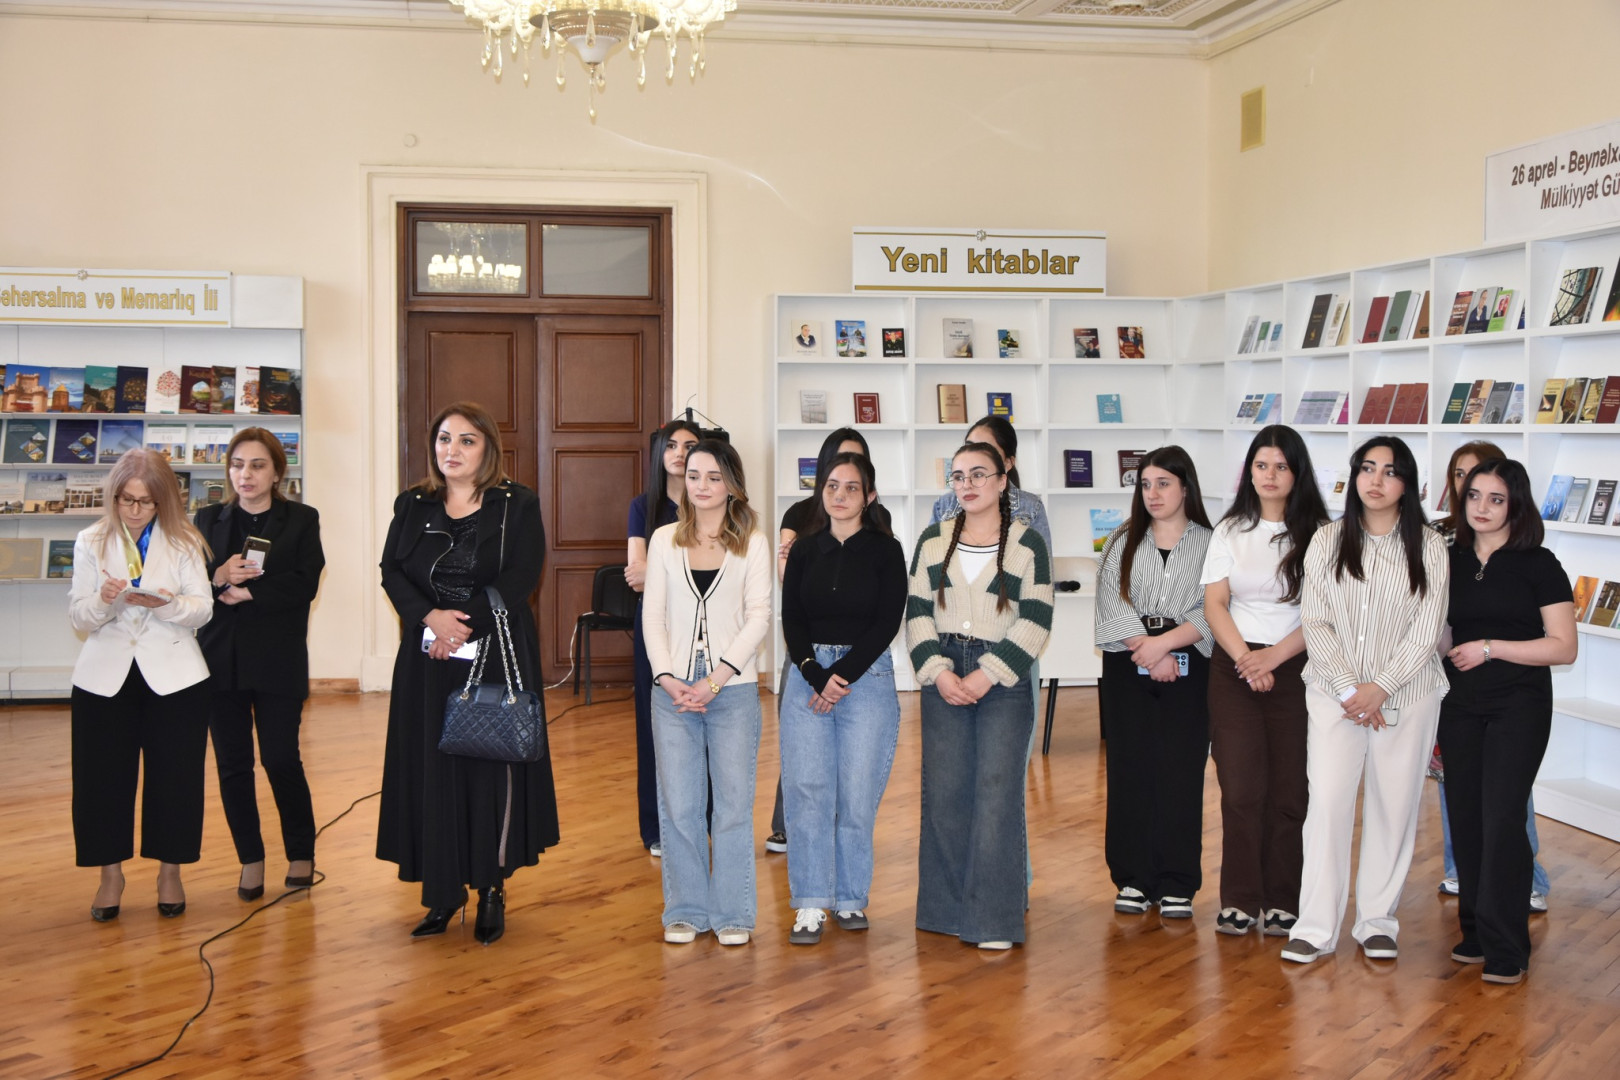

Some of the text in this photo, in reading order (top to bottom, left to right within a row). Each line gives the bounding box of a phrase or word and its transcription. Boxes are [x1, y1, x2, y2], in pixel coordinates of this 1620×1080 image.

[1511, 164, 1525, 186] 26
[1527, 156, 1557, 187] aprel
[1540, 179, 1599, 210] Mülkiyyət
[881, 246, 1080, 275] Yeni kitablar
[0, 285, 86, 308] əhərsalma
[96, 293, 114, 309] və
[122, 287, 195, 315] Memarlıq
